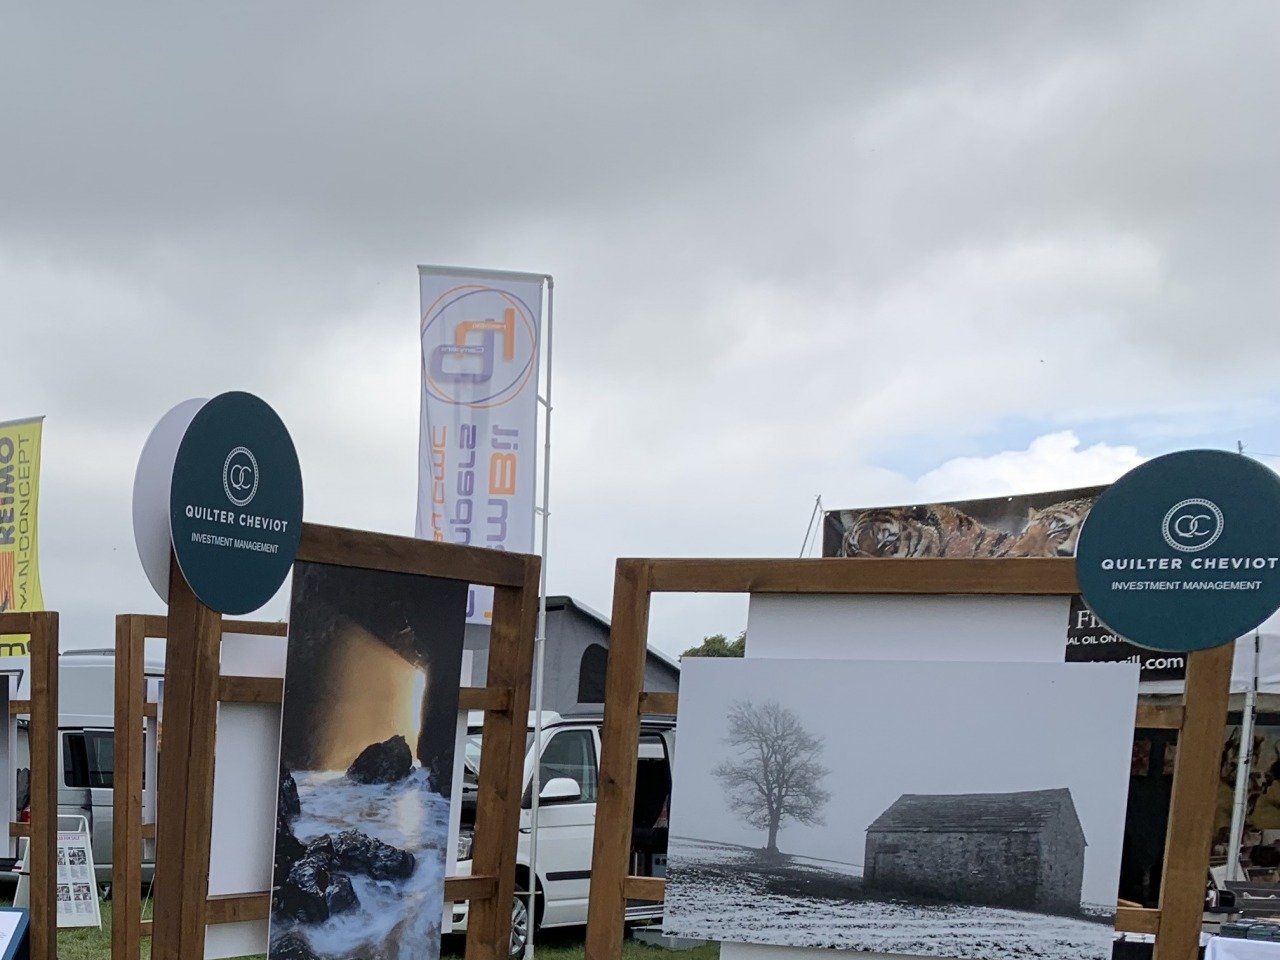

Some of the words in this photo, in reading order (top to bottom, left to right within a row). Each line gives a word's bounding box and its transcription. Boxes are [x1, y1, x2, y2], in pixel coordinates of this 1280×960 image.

[185, 505, 235, 524] QUILTER
[239, 514, 288, 532] CHEVIOT
[191, 532, 233, 547] INVESTMENT
[234, 539, 279, 553] MANAGEMENT
[1101, 558, 1183, 570] QUILTER
[1190, 557, 1279, 570] CHEVIOT
[1111, 581, 1181, 590] INVESTMENT
[1182, 581, 1262, 590] MANAGEMENT
[1081, 635, 1099, 643] OIL
[1100, 634, 1117, 643] ON
